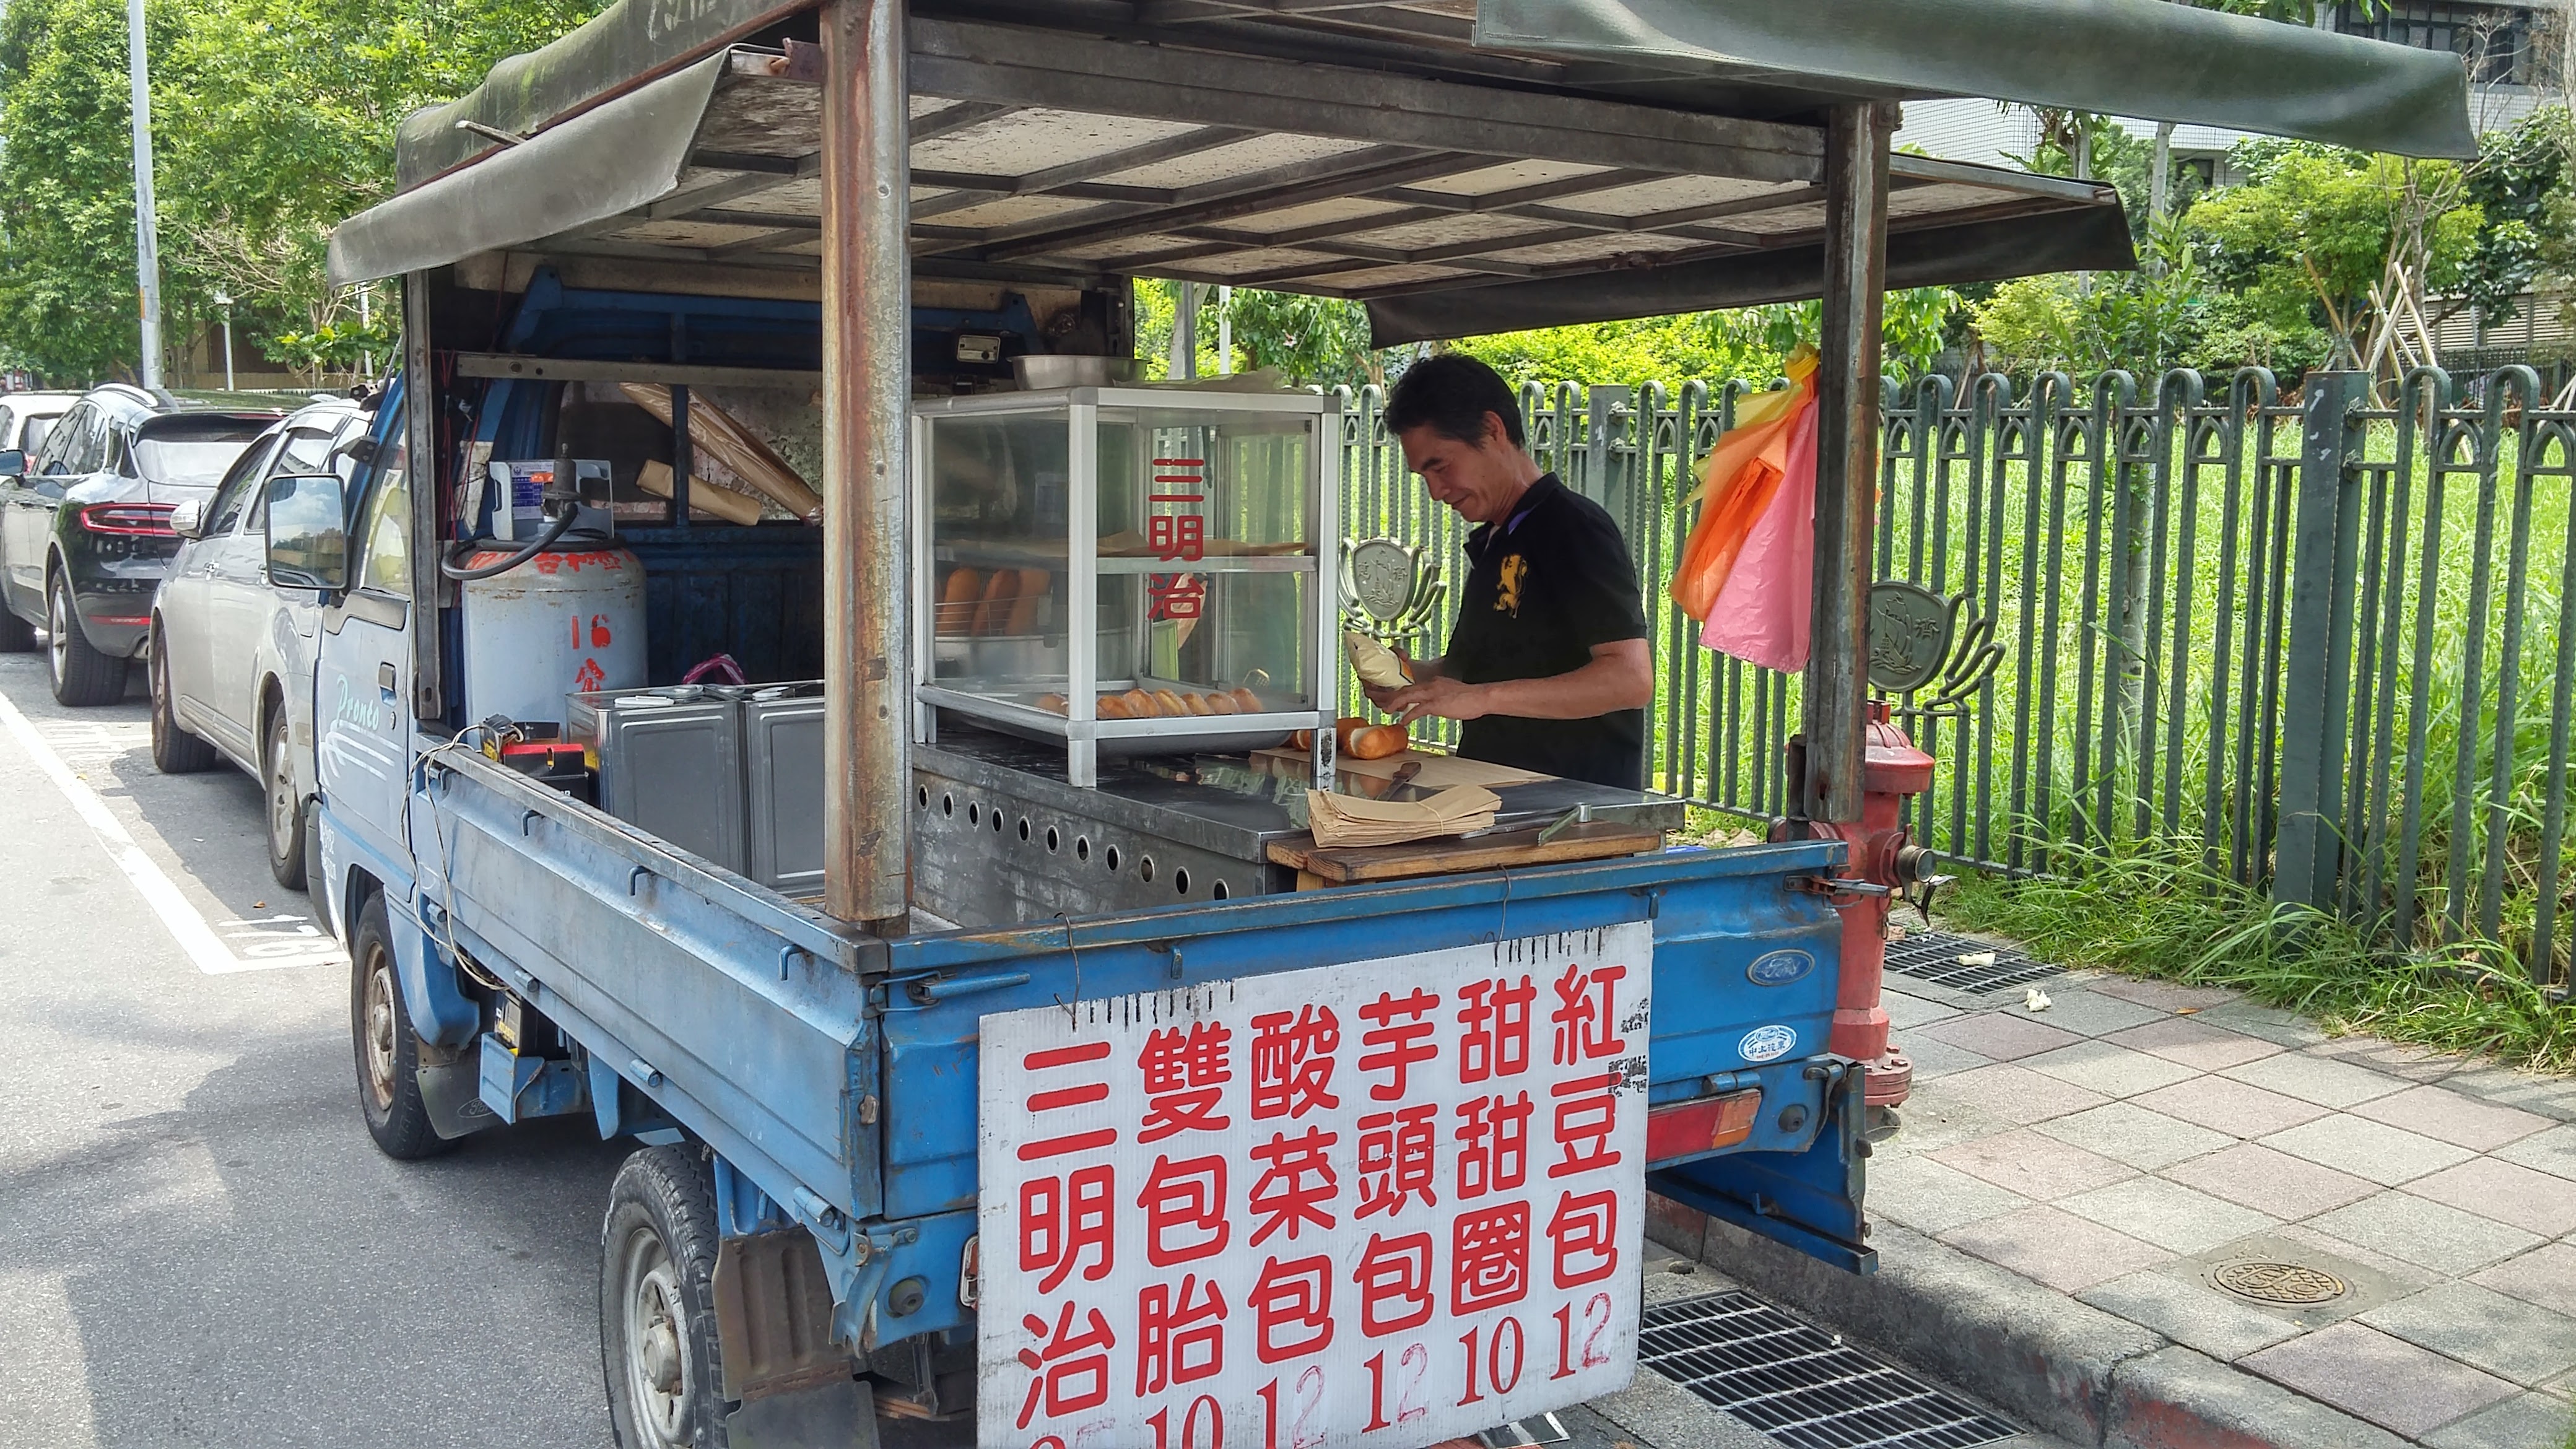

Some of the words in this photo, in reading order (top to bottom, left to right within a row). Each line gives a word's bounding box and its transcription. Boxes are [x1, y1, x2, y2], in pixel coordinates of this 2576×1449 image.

[1147, 458, 1204, 620] 三明治
[571, 614, 612, 650] 16
[336, 673, 380, 731] Pronto
[1247, 1003, 1341, 1365] 酸菜包
[1352, 987, 1440, 1339] 芋頭包
[1450, 974, 1538, 1317] 甜甜圈
[1545, 963, 1627, 1292] 紅豆包
[1016, 1041, 1118, 1430] 三明治
[1135, 1020, 1232, 1399] 雙包胎
[1360, 1342, 1430, 1434] 12
[1456, 1315, 1526, 1407] 10
[1549, 1291, 1612, 1382] 12
[1144, 1393, 1225, 1449] 10
[1255, 1364, 1327, 1449] 12
